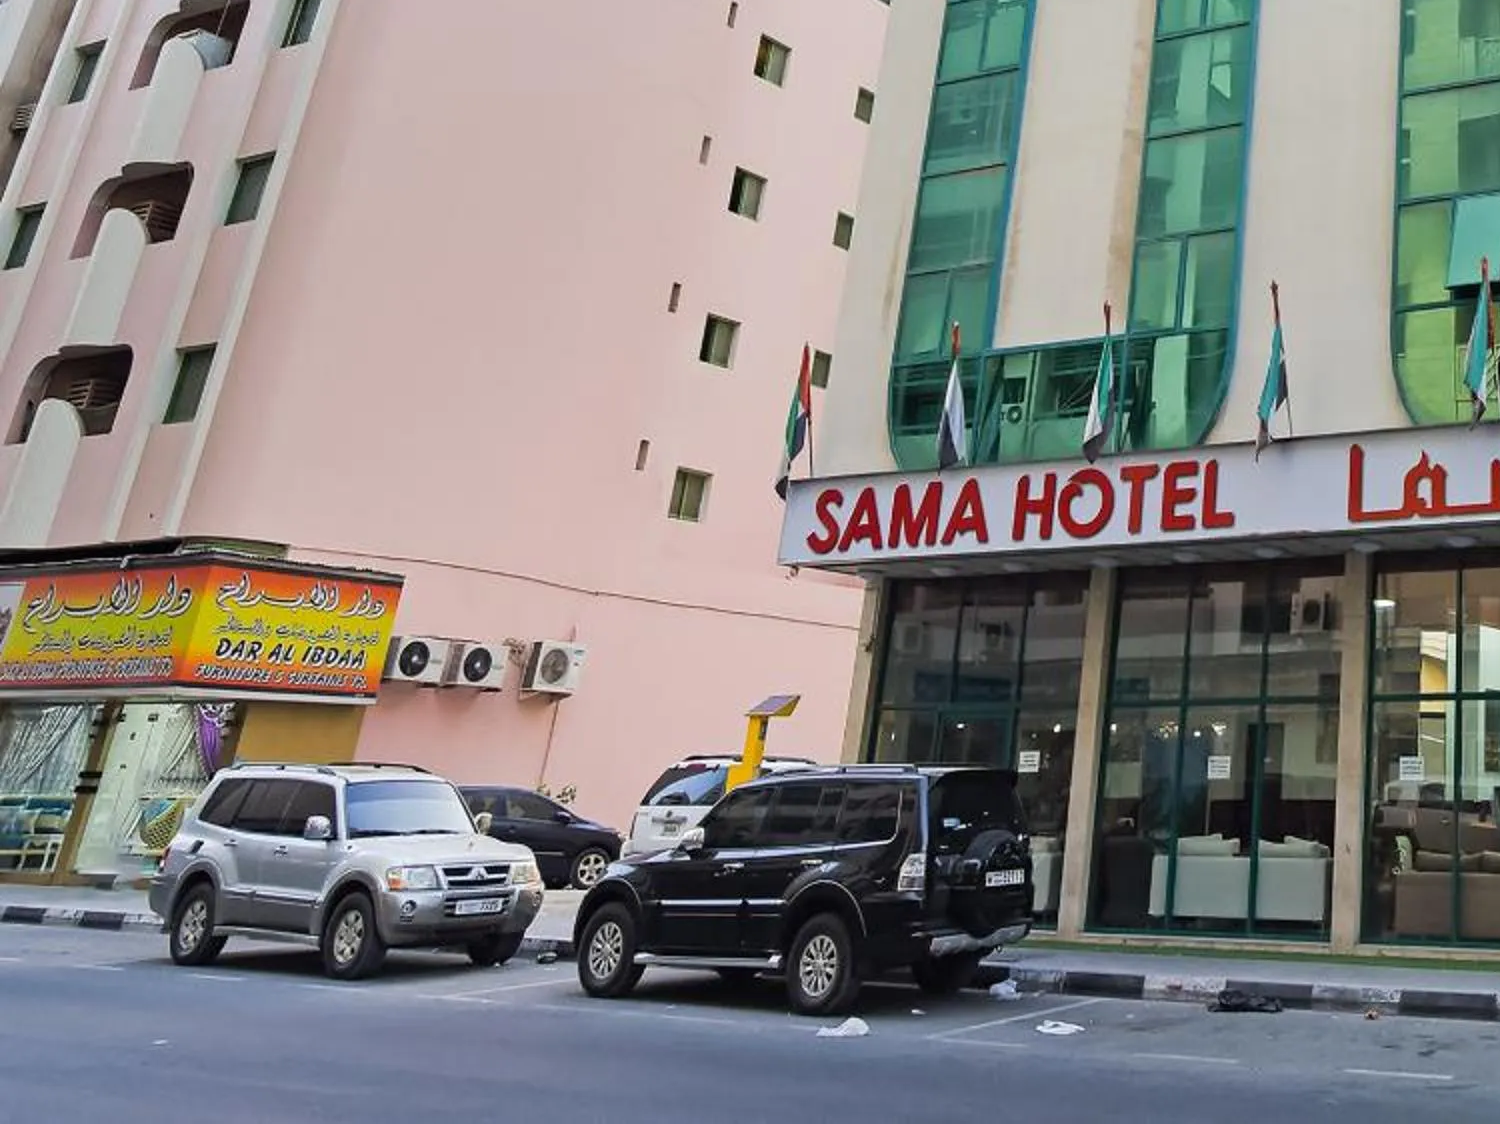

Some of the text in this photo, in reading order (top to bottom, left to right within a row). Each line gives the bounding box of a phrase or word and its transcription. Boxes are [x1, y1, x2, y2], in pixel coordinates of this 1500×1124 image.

[806, 458, 1235, 554] SAMA HOTEL
[138, 573, 193, 620] دار
[339, 588, 385, 619] دار
[215, 637, 368, 671] DAR AL IBDAA
